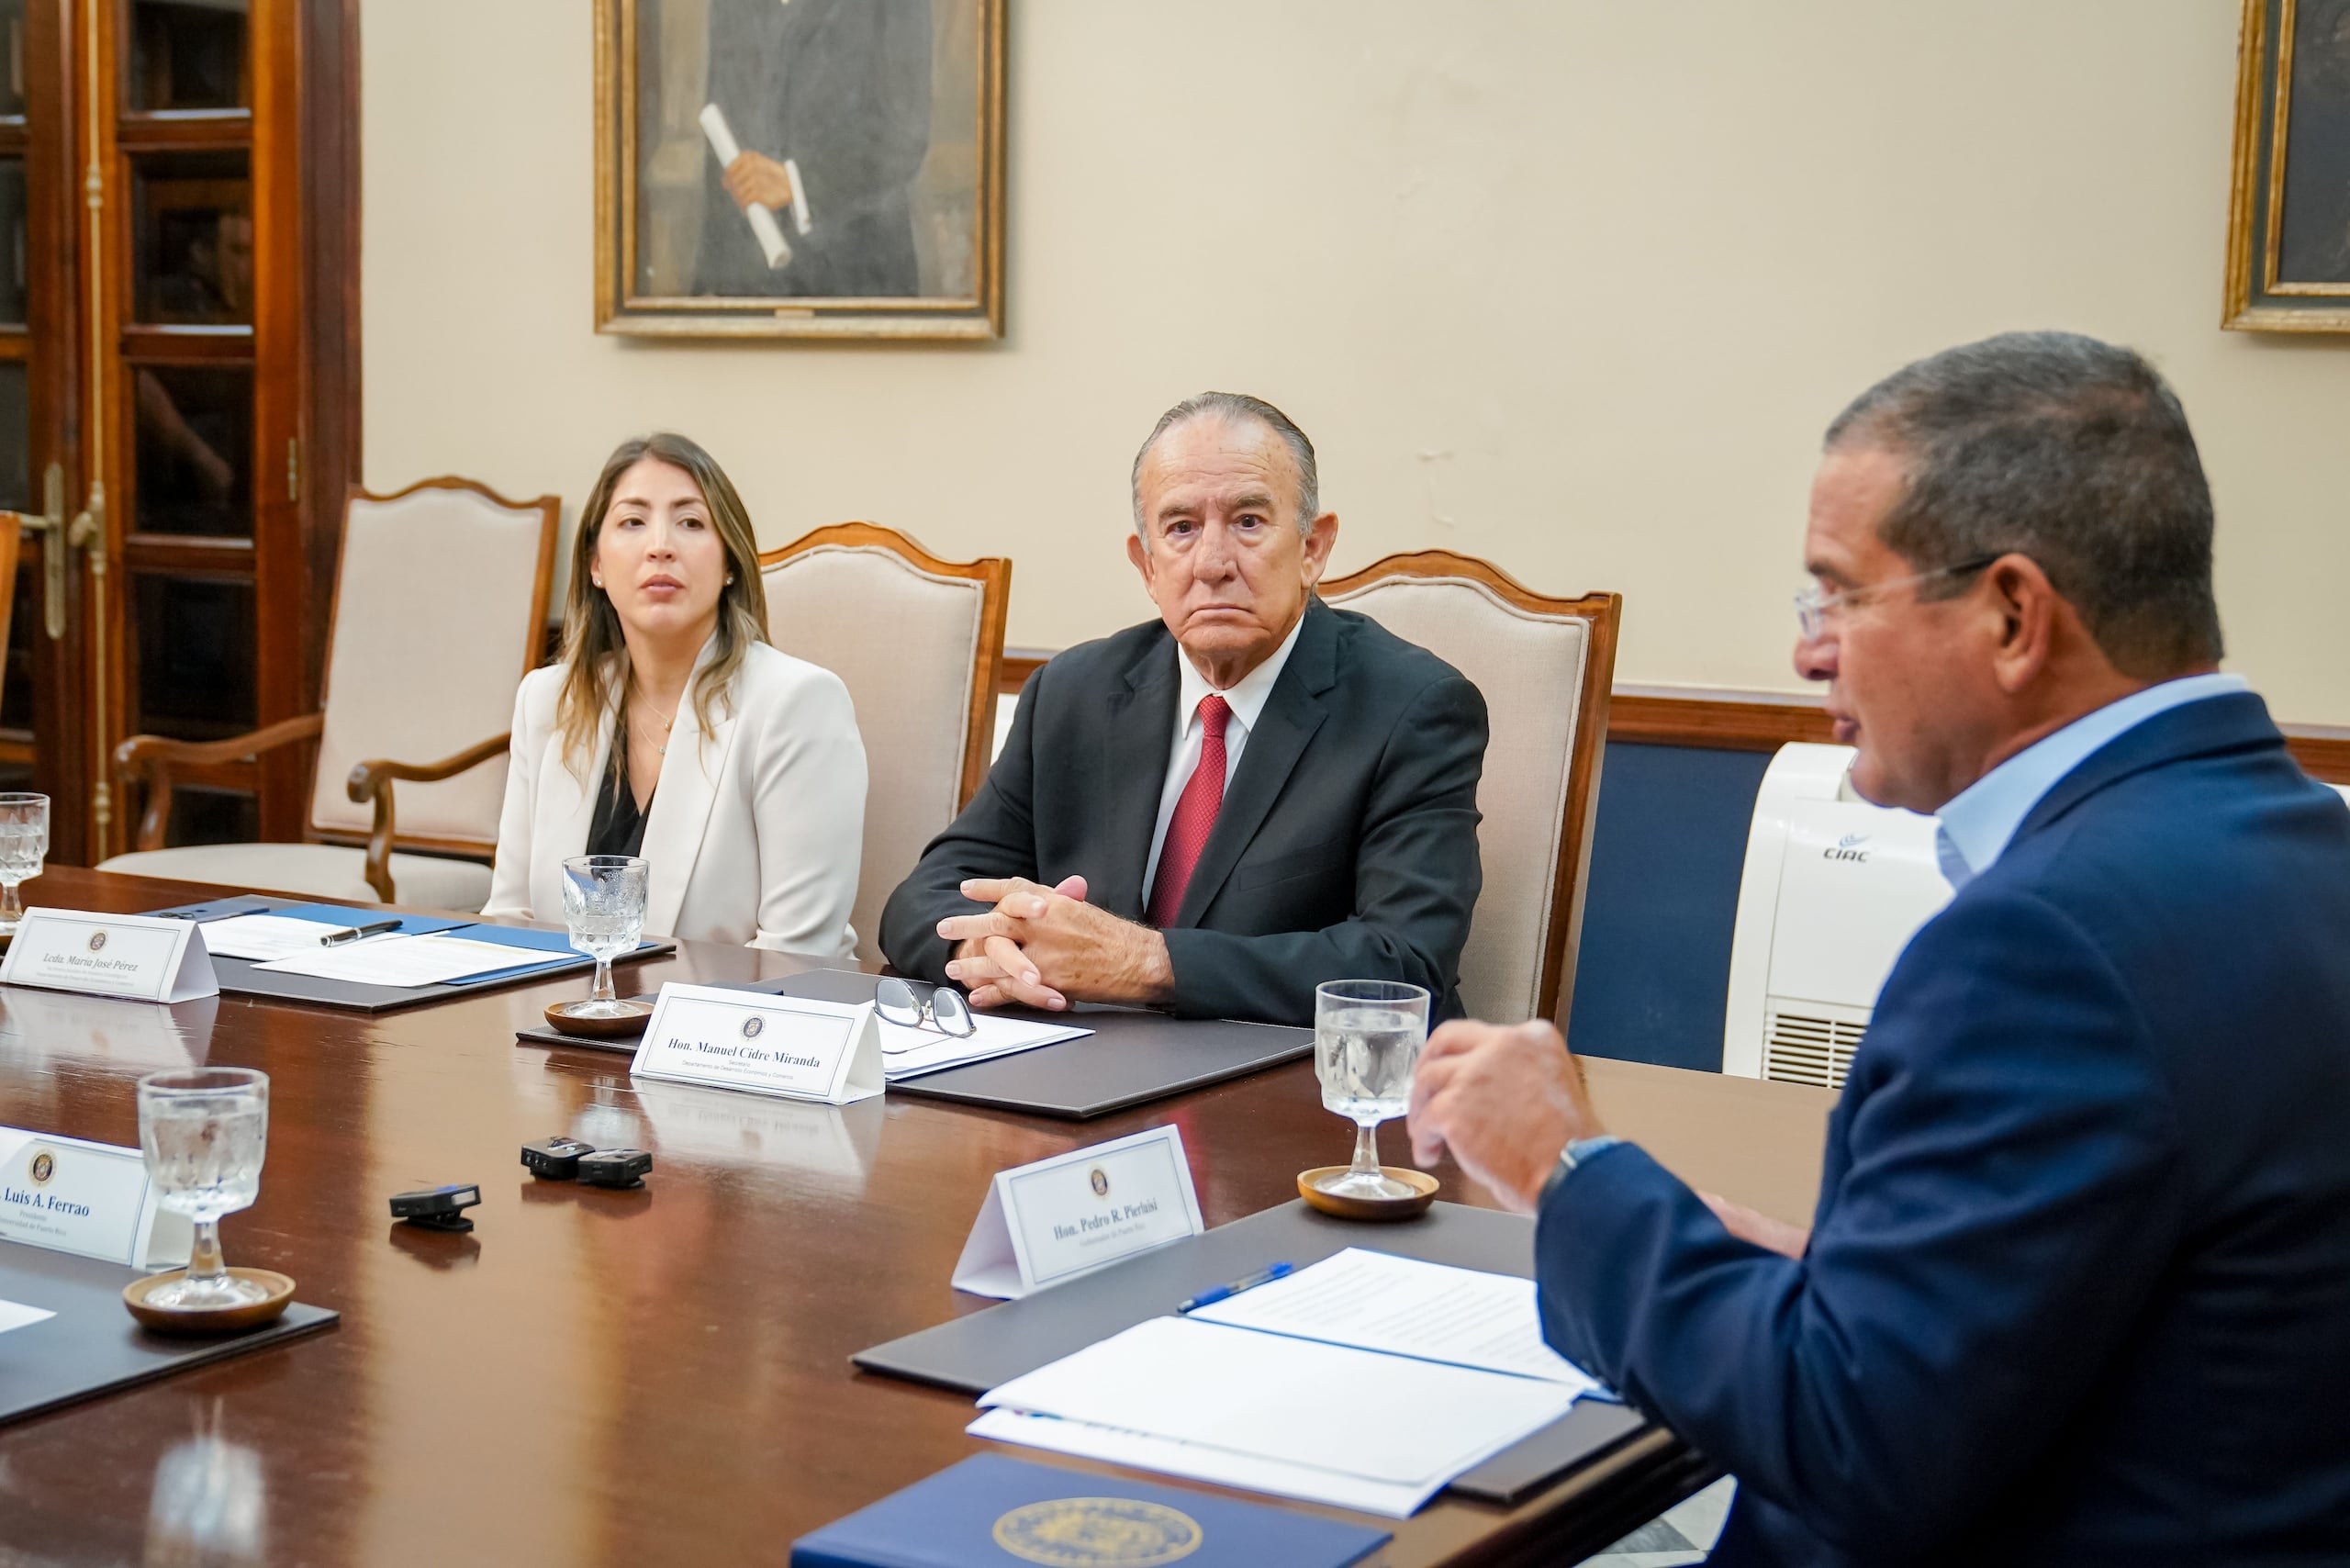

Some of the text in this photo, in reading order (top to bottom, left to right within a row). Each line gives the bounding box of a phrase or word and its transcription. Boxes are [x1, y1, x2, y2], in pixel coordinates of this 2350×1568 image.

[1823, 847, 1870, 862] CIAC
[93, 958, 112, 969] José
[113, 959, 139, 971] Pérez
[667, 1038, 820, 1069] Hon. Manuel Cidre Miranda
[5, 1187, 90, 1216] Luis A. Ferrao
[1053, 1225, 1079, 1240] Hon.
[1080, 1215, 1110, 1232] Pedro
[1111, 1207, 1123, 1223] R.
